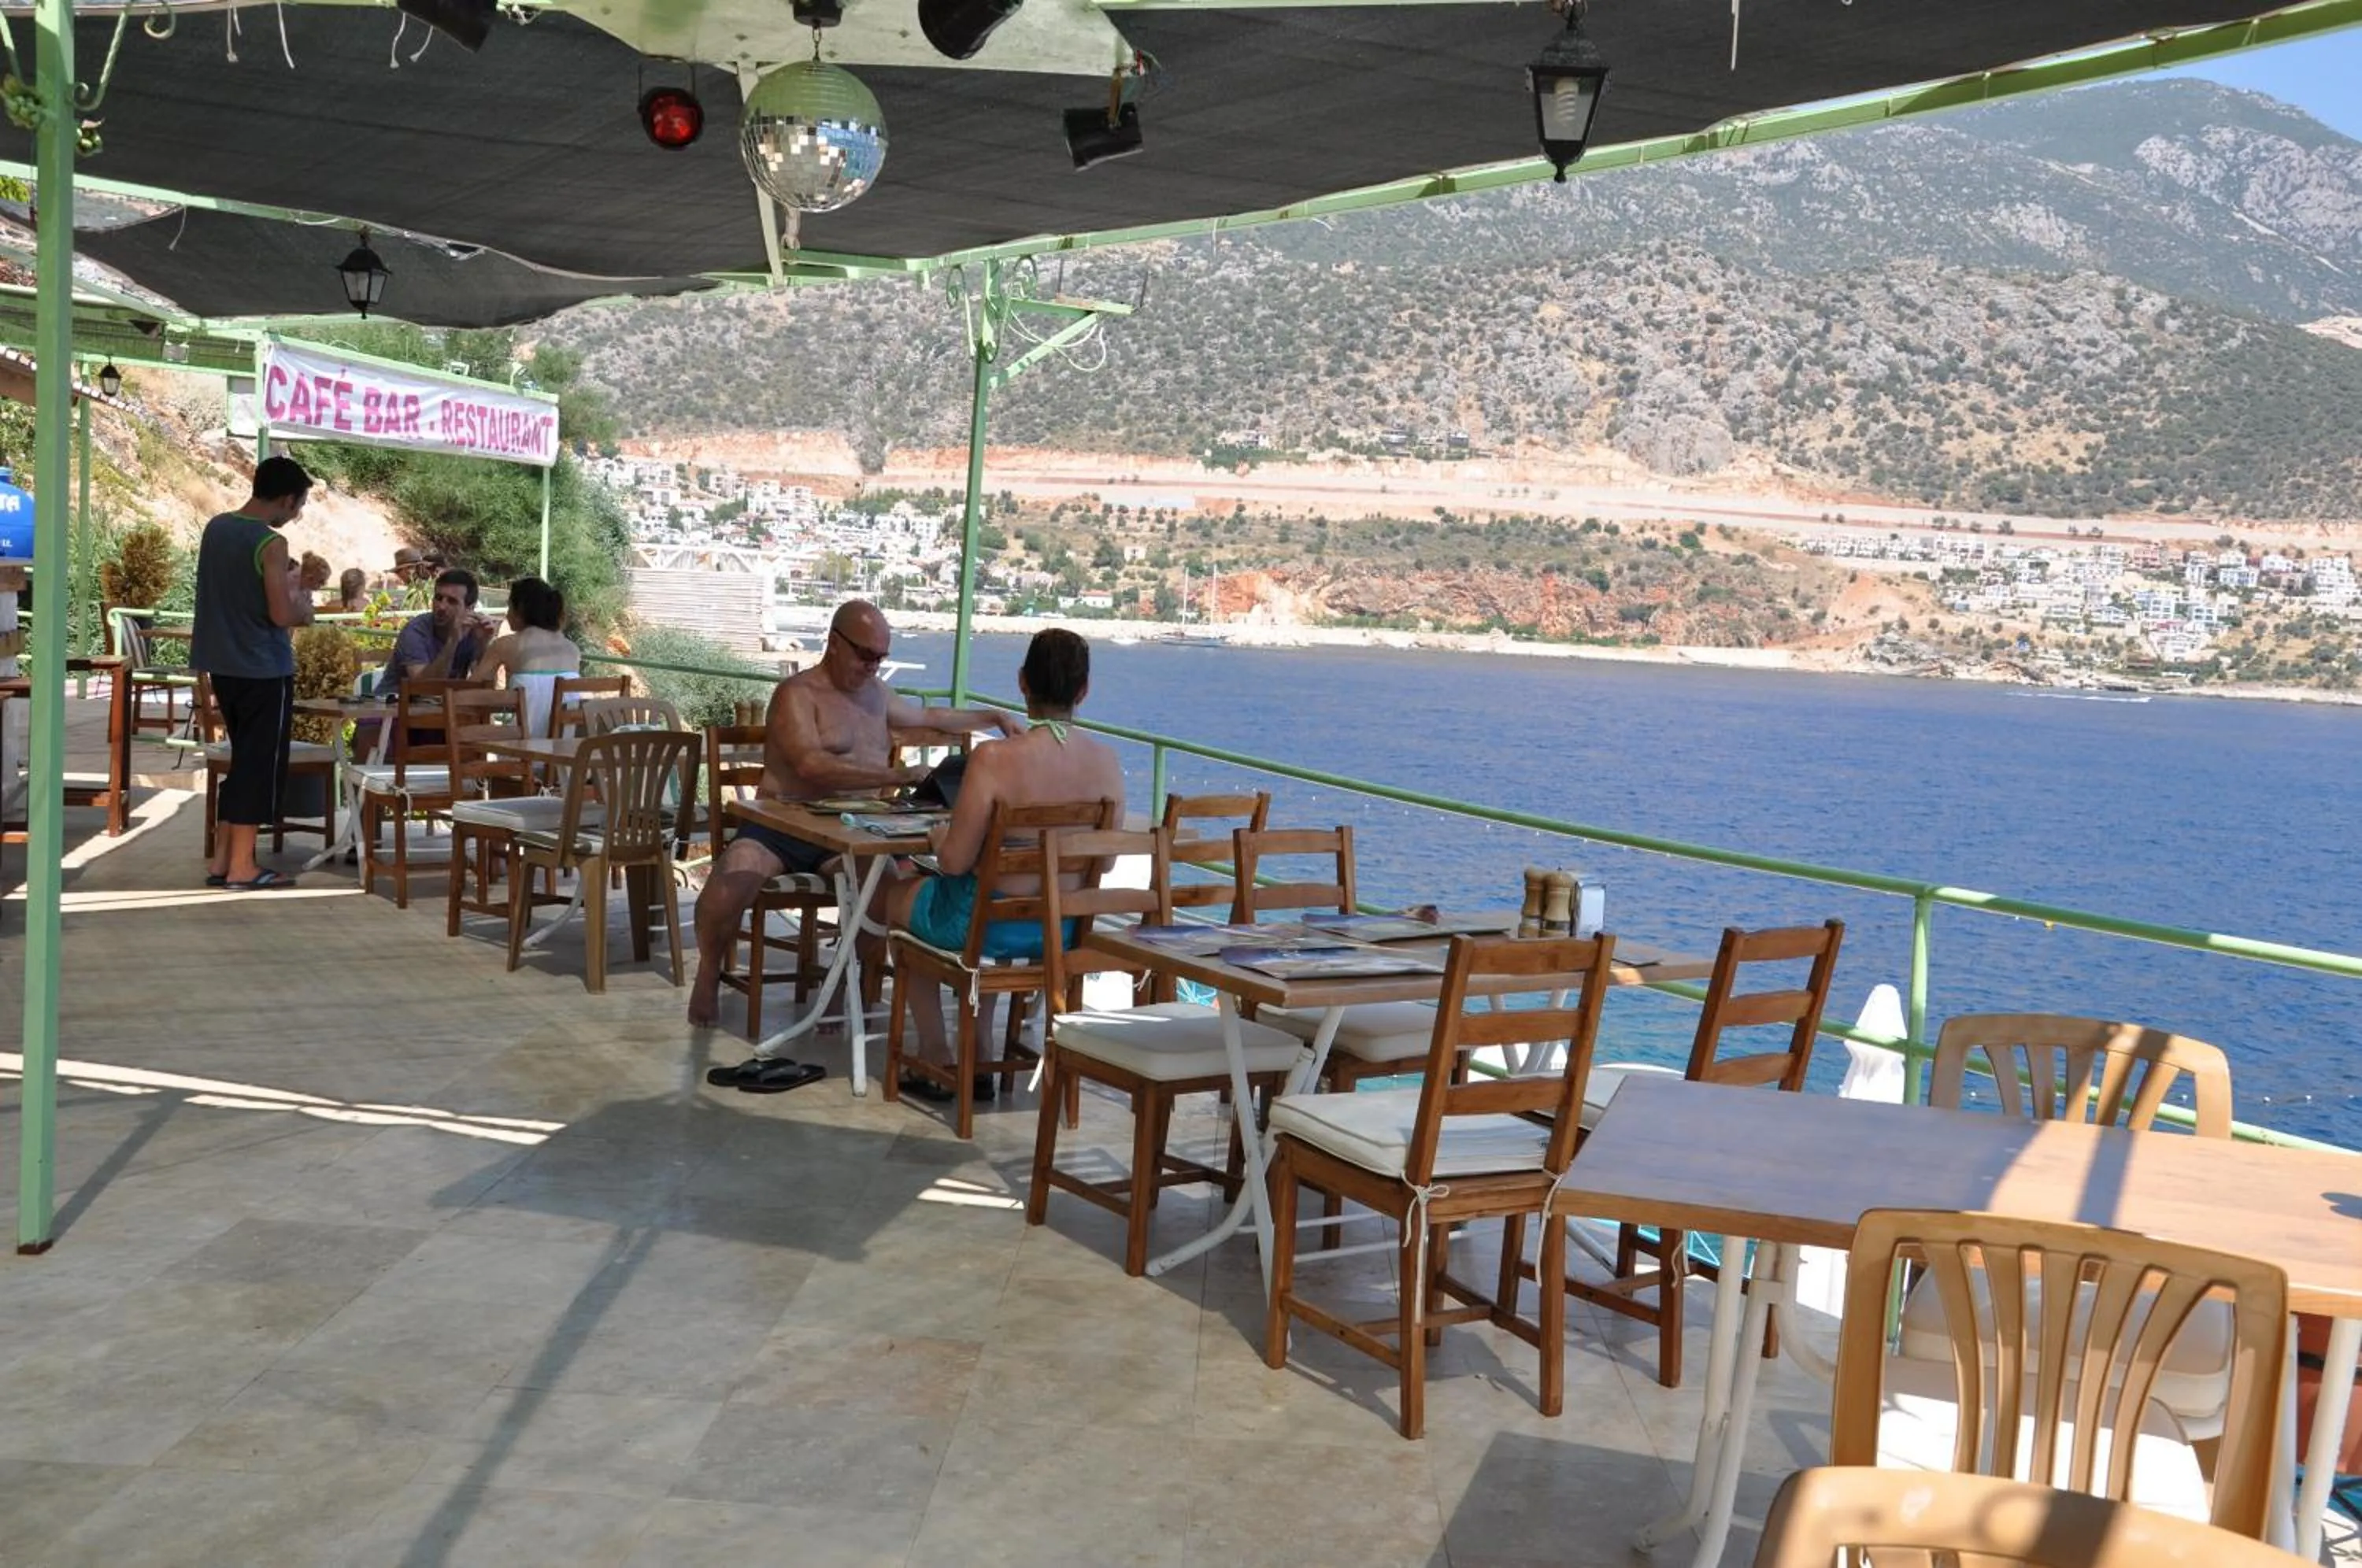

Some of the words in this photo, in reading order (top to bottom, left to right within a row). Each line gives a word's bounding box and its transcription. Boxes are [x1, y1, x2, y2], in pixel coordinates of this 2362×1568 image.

[265, 365, 353, 431] CAFÉ
[363, 386, 420, 434] BAR
[441, 399, 553, 457] RESTAURANT
